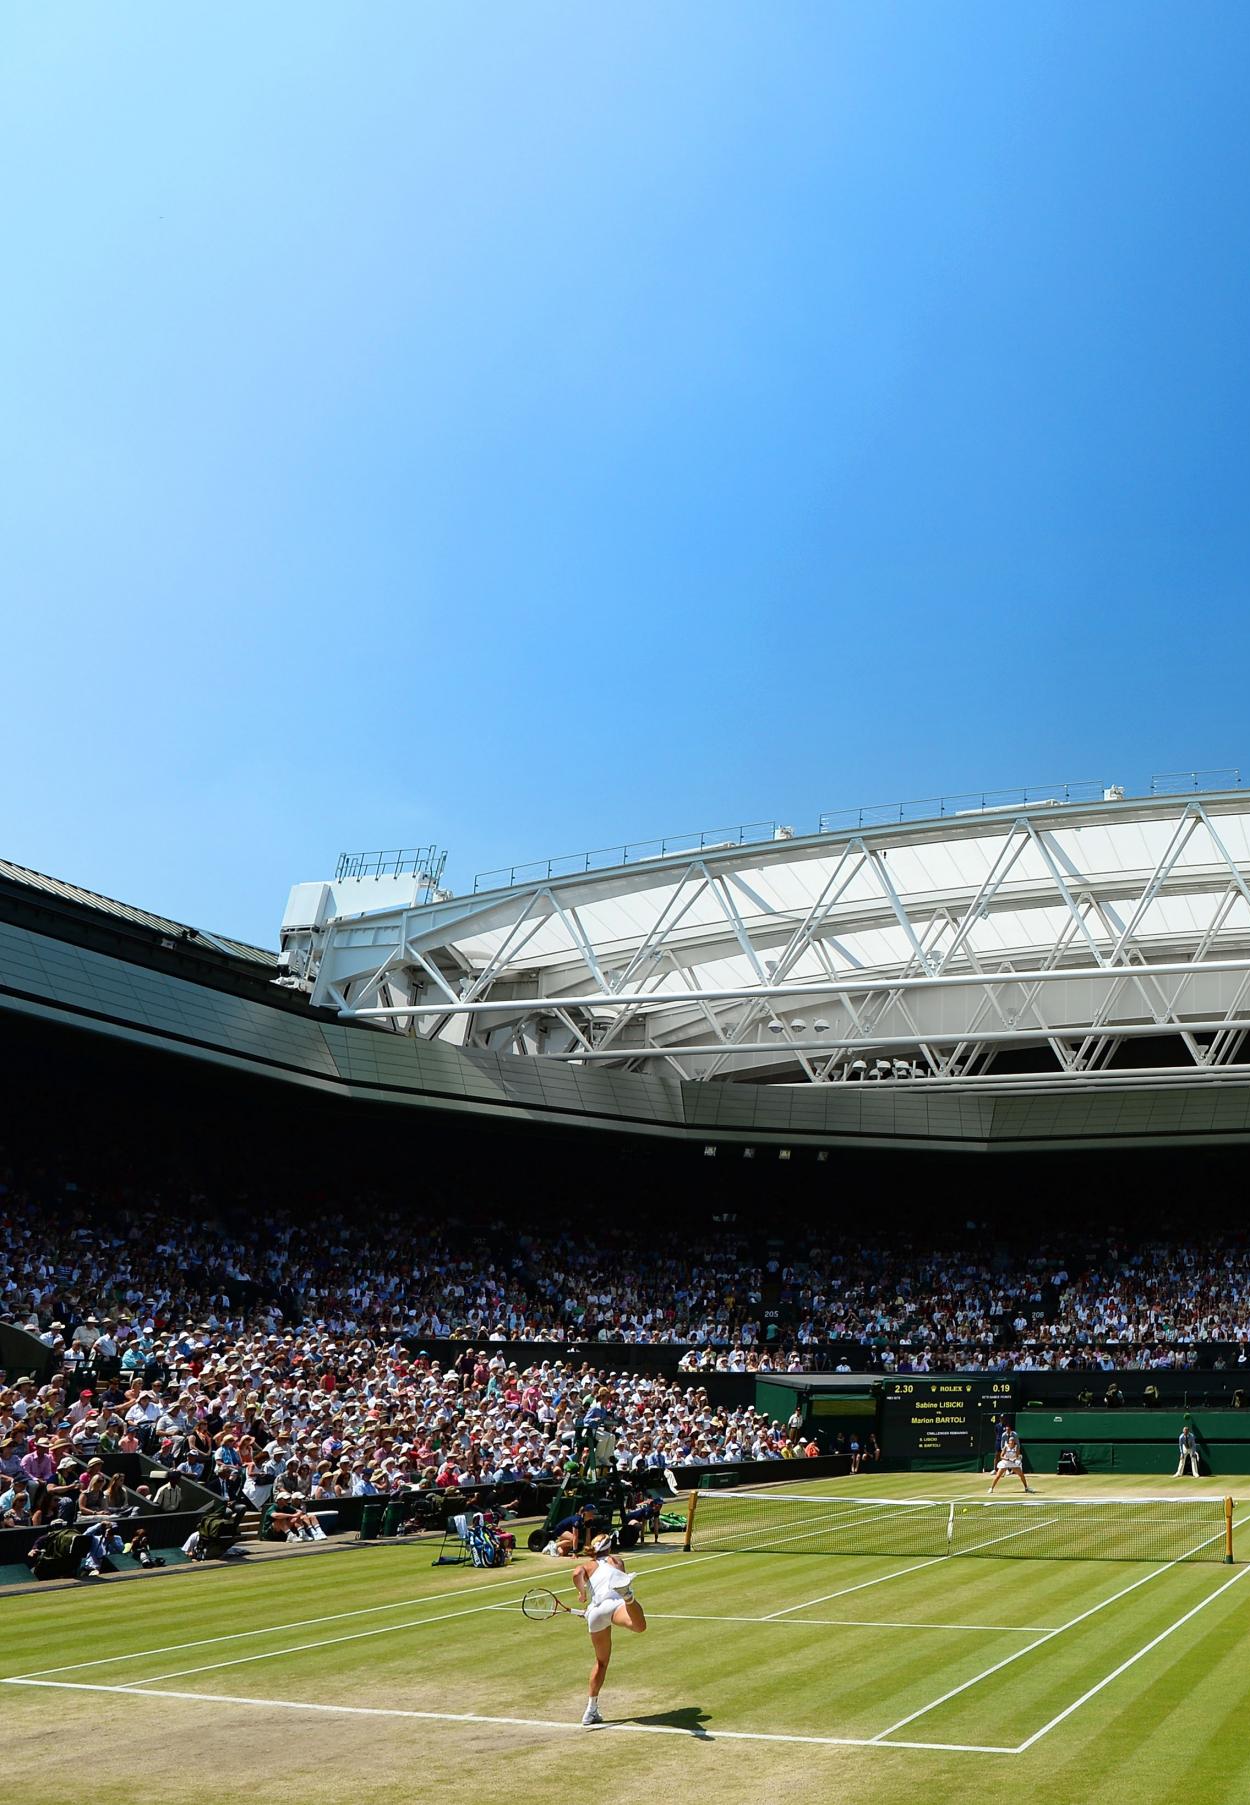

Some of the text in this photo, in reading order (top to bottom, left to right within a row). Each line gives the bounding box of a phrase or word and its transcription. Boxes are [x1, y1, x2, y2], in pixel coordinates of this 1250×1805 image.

[765, 1310, 779, 1318] 205
[894, 1384, 914, 1393] 2.30
[992, 1384, 1011, 1393] 0.19
[915, 1401, 964, 1409] Sabine LISICKI
[992, 1400, 997, 1408] 1
[935, 1416, 966, 1424] BARTOLI
[990, 1415, 996, 1423] 4
